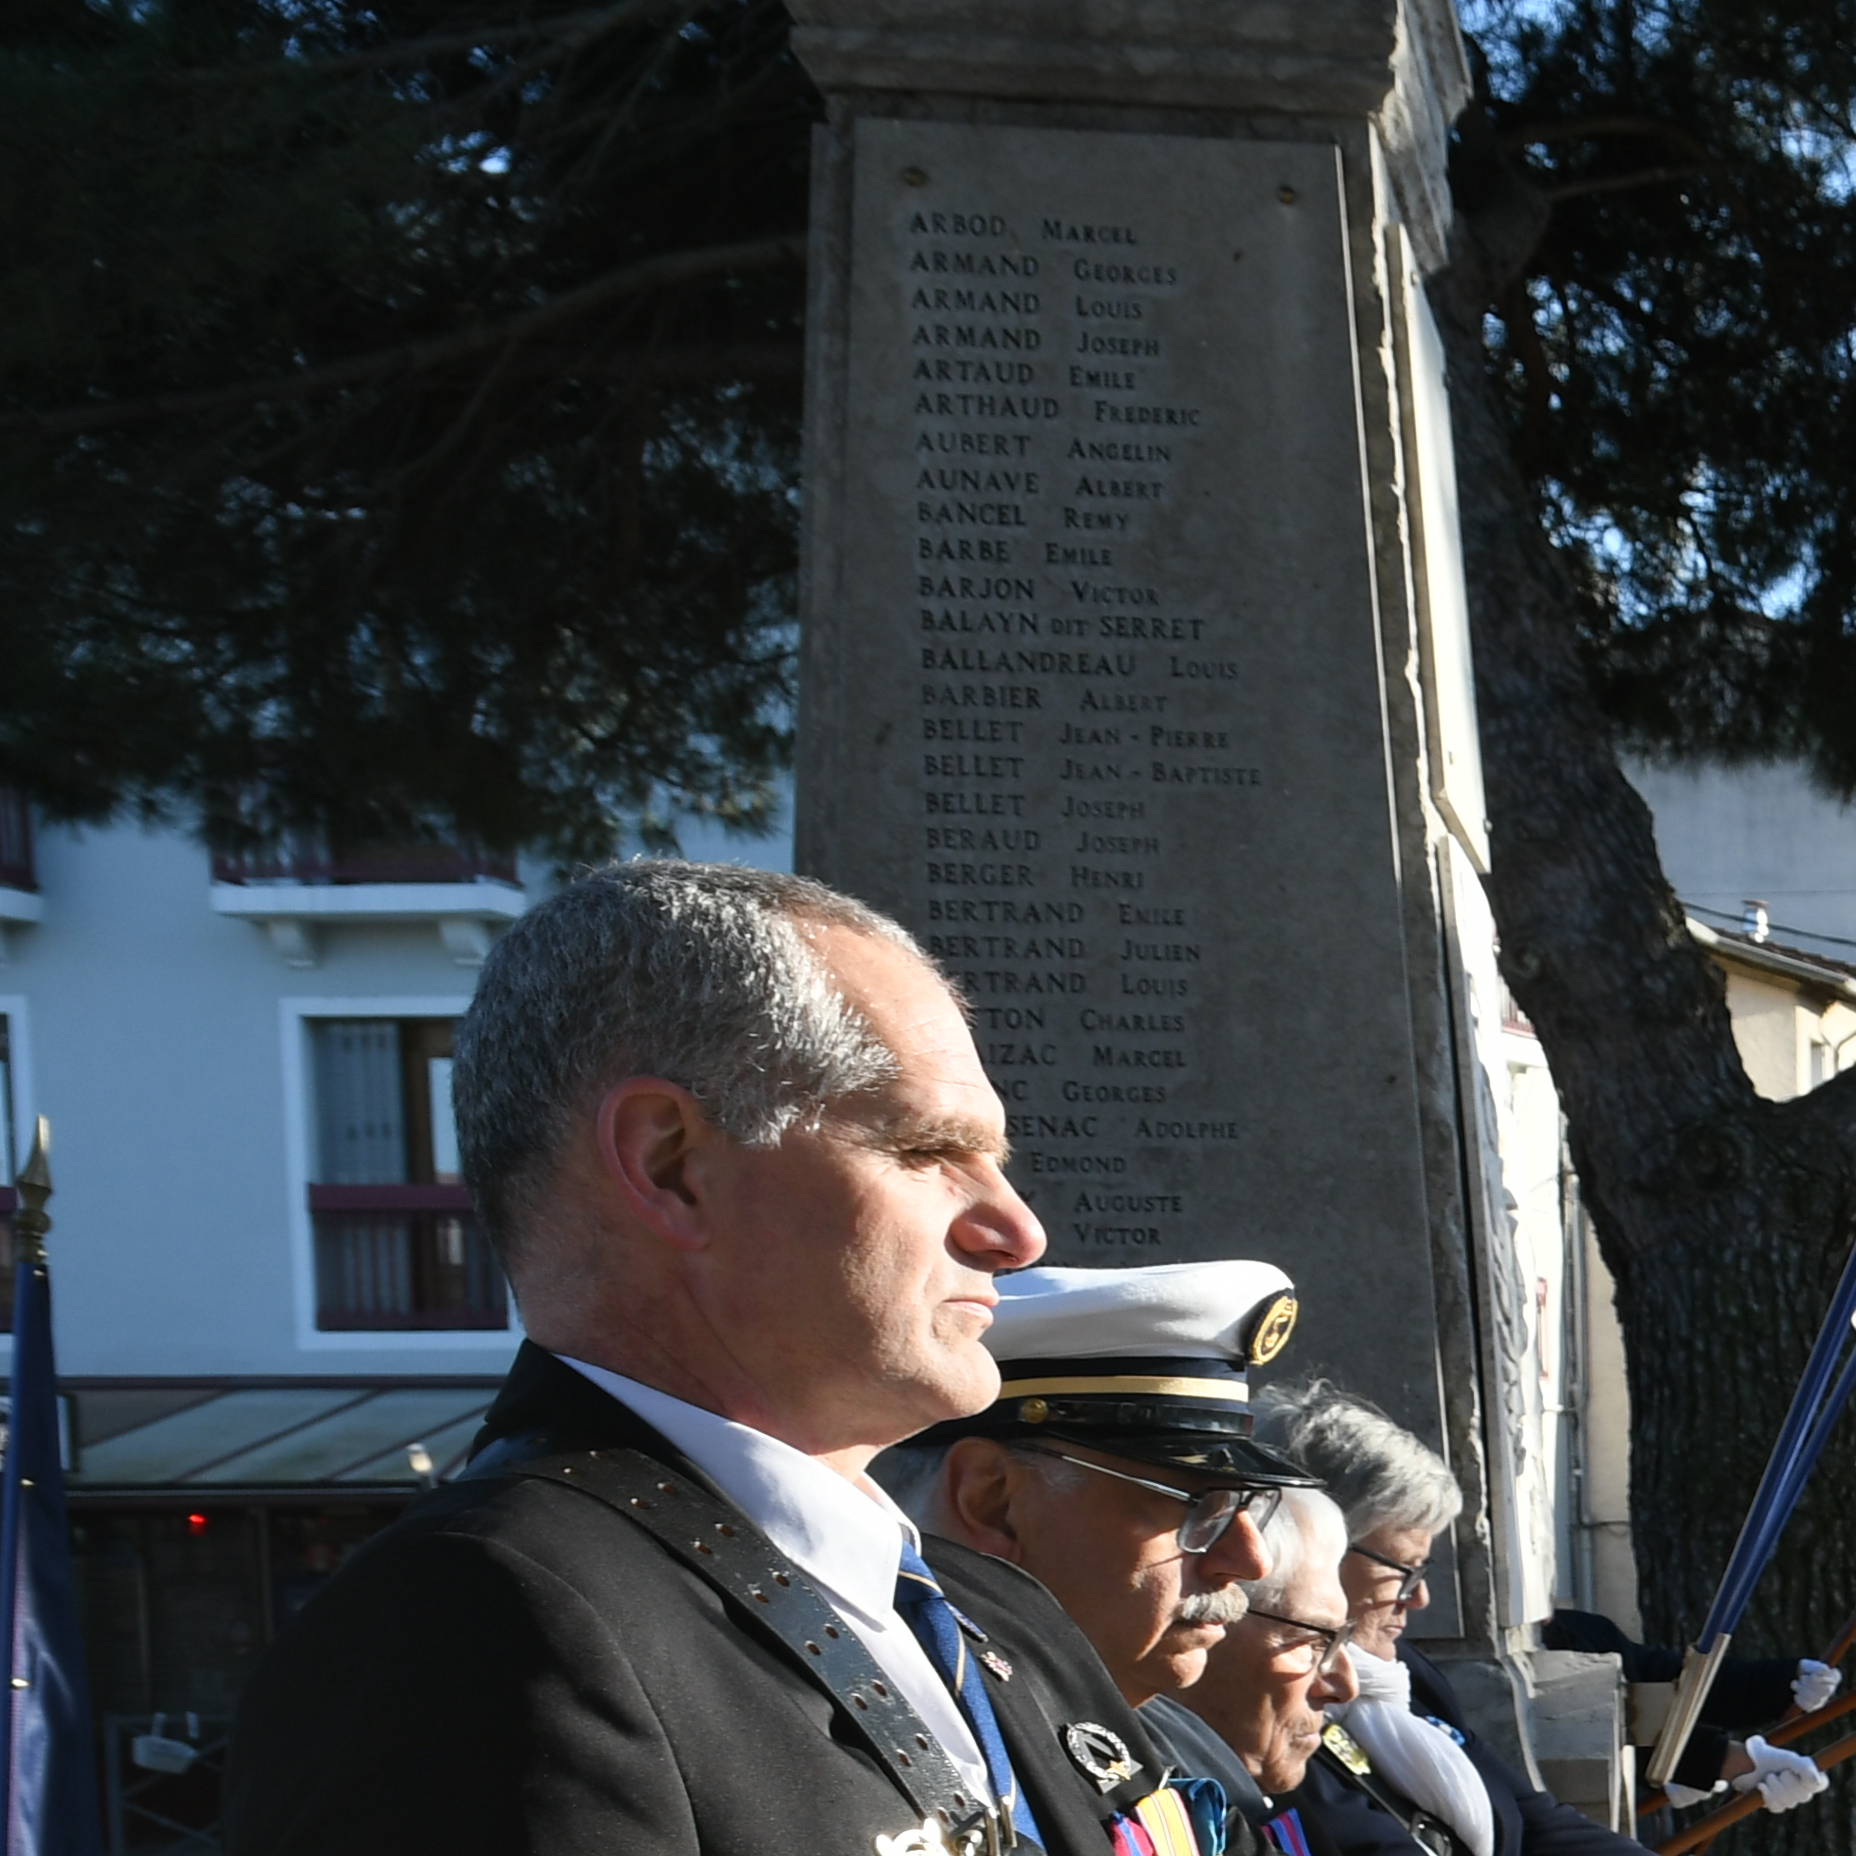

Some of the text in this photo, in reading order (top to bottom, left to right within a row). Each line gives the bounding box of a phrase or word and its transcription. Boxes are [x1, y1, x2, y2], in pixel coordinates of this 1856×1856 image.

[910, 212, 1138, 246] ARBOD MARCEL
[910, 250, 1178, 286] ARMAND GEORGES
[911, 287, 1143, 320] ARMAND LOUIS
[911, 324, 1161, 357] ARMAND JOSEPH
[913, 358, 1136, 390] ARTAUD EMILE
[914, 393, 1201, 428] ARTHAUD FREDERIC
[916, 431, 1172, 462] AUBERT ANGELIN
[917, 469, 1163, 500] AUNAVE ALBERT
[917, 501, 1131, 530] BANCEL REMY
[918, 538, 1113, 567] BARBE EMILE
[919, 576, 1161, 606] BARJON VICTOR
[920, 609, 1206, 641] BALAYN DIT SERRET
[921, 648, 1240, 680] BALLANDREAU LOUIS
[922, 684, 1168, 713] BARBIER ALBERT
[922, 719, 1024, 743] BELLET
[924, 755, 1025, 778] BELLET
[925, 792, 1145, 820] BELLET JOSEPH
[926, 827, 1161, 855] BERAUD JOSEPH
[927, 862, 1144, 889] BERGER HENRI
[928, 900, 1186, 927] BERTRAND EMILE
[1120, 939, 1201, 962] JULIEN
[1122, 974, 1190, 999] LOUIS
[1080, 1010, 1186, 1033] CHARLES
[1093, 1045, 1187, 1068] MARCEL
[1062, 1080, 1167, 1104] GEORGES
[1135, 1118, 1240, 1140] ADOLPHE
[1031, 1151, 1126, 1174] EDMOND
[1073, 1191, 1183, 1214] AUGUSTE
[1072, 1223, 1162, 1246] VICTOR
